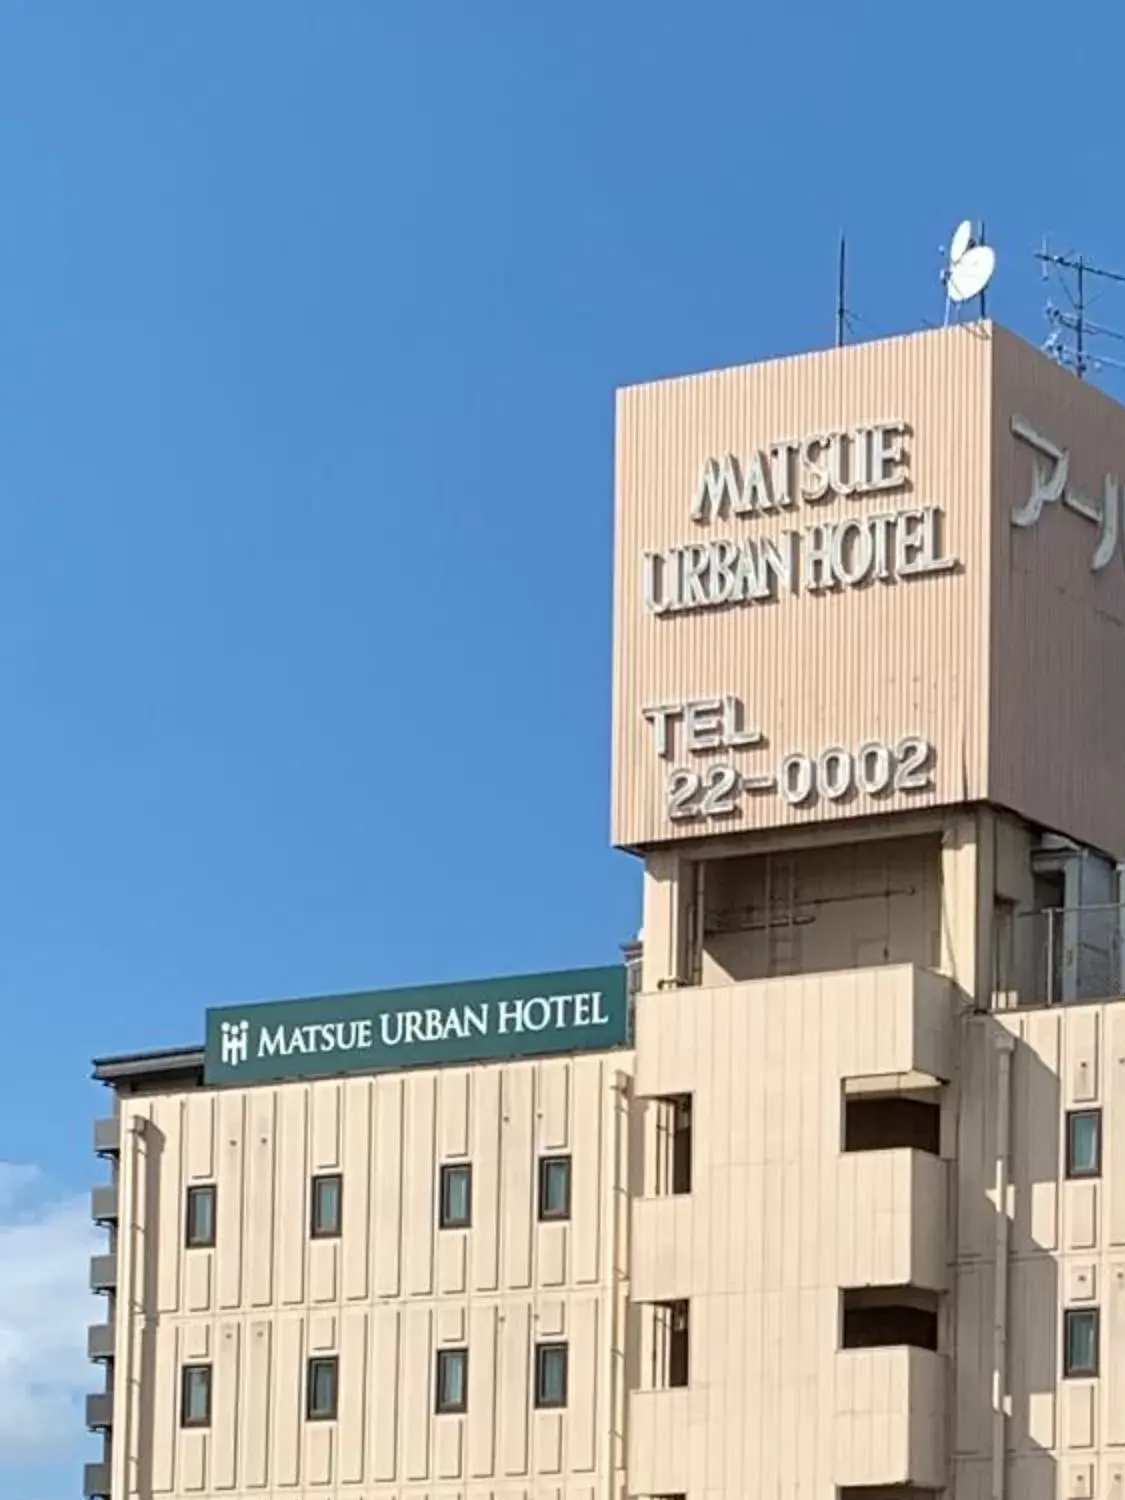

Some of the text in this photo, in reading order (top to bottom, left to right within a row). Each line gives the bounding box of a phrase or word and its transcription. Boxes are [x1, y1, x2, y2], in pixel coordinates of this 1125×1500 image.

[691, 420, 912, 522] MATSUE
[643, 504, 959, 617] URBAN HOTEL
[642, 693, 765, 758] TEL
[665, 734, 937, 821] 22-0002
[256, 991, 609, 1059] MATSUE URBAN HOTEL
